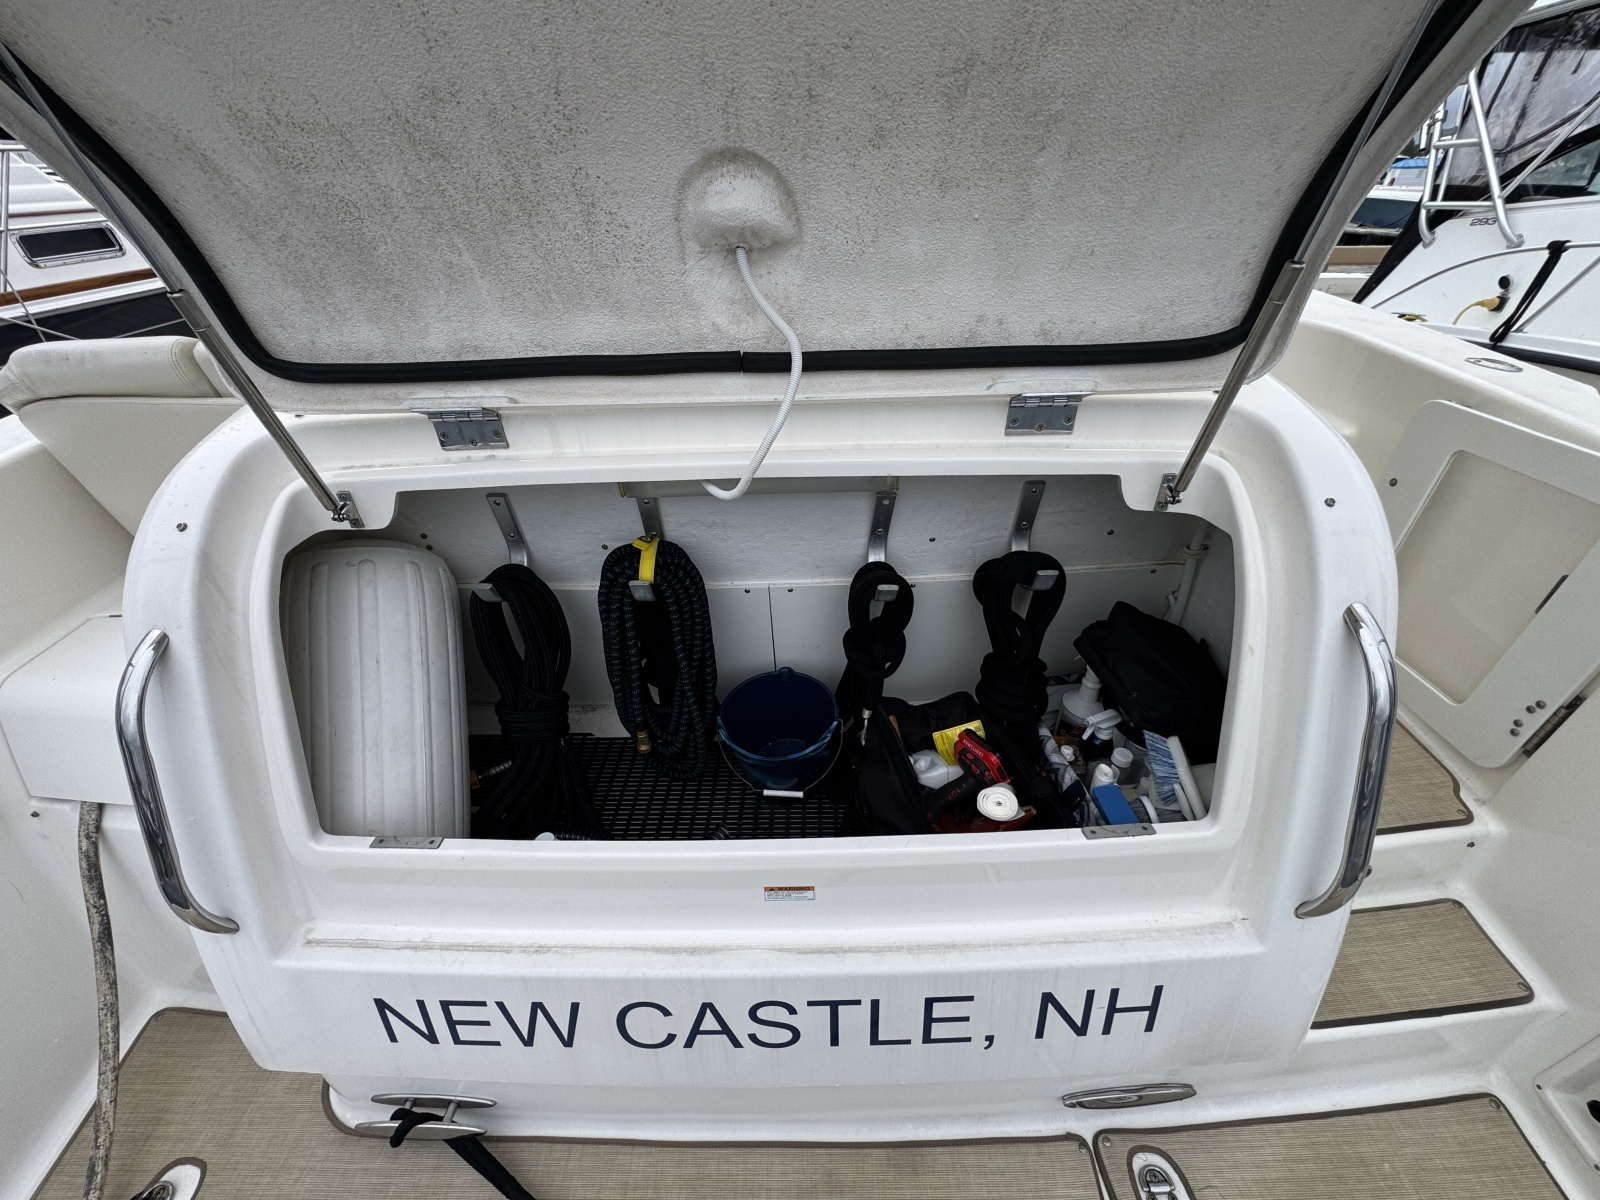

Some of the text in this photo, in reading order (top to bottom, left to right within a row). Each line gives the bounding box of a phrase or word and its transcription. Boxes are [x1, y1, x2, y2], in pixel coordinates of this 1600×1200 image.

[373, 984, 1164, 1051] NEW CASTLE, NH
